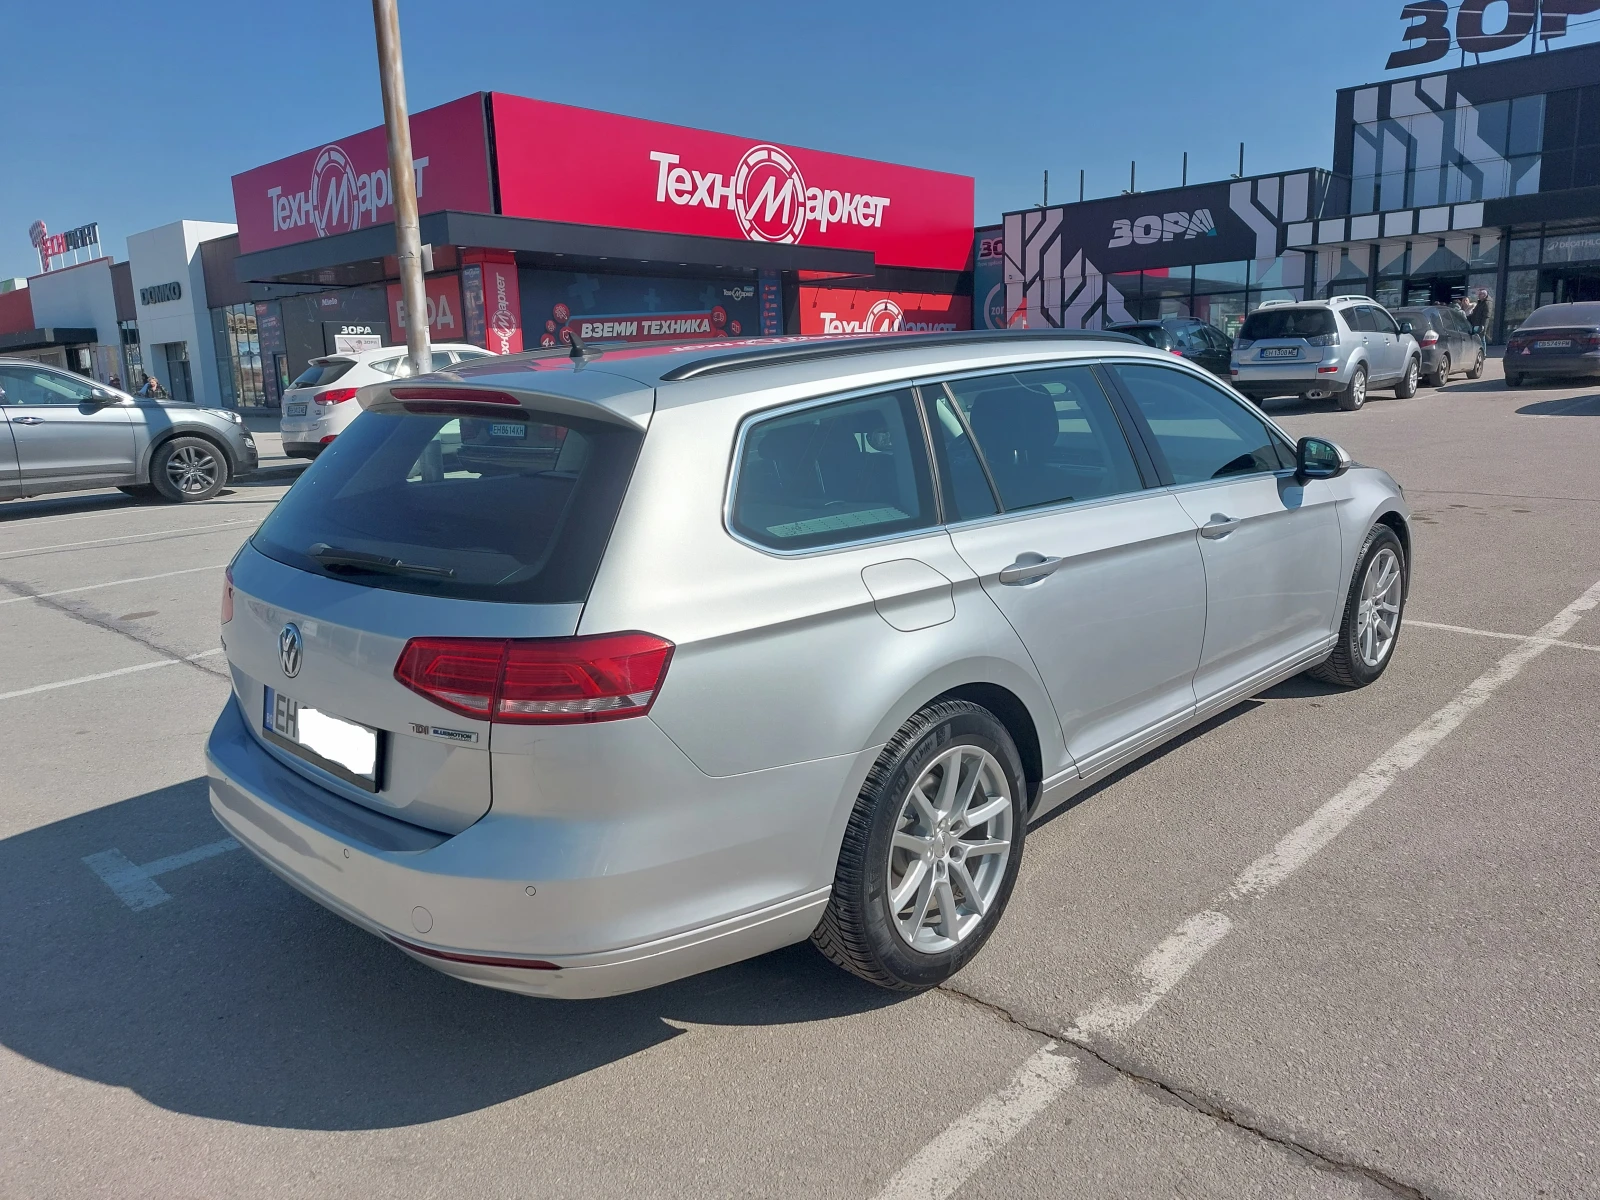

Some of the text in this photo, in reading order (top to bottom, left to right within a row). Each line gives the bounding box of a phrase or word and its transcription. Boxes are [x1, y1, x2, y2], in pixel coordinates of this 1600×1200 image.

[1108, 208, 1217, 248] ЗОРА
[341, 325, 372, 335] ЗОРА
[581, 318, 711, 338] ВЗЕМИ ТЕХНИКА
[408, 722, 429, 735] TDI
